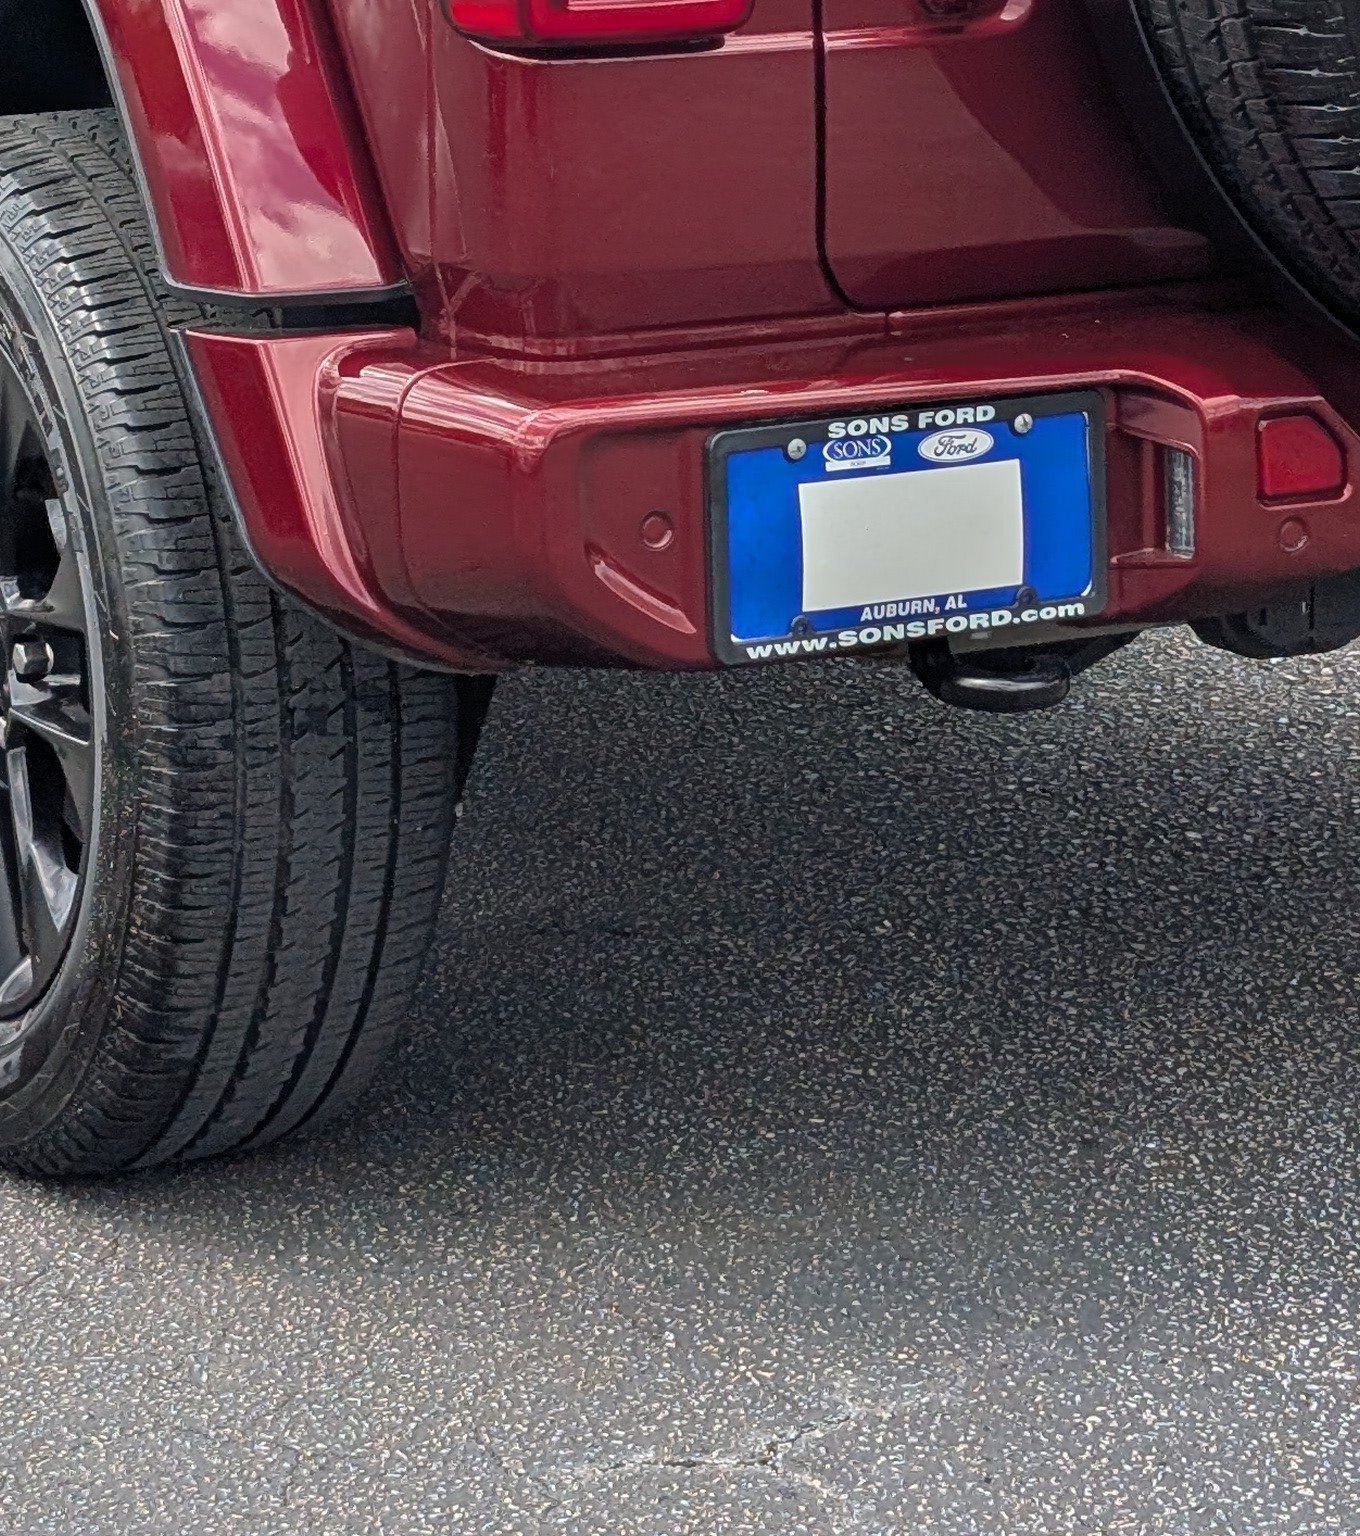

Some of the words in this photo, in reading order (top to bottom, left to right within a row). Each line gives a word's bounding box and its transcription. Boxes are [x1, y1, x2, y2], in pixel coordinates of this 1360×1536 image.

[828, 413, 908, 438] SONS
[919, 405, 996, 430] FORD
[831, 436, 882, 460] SONS
[933, 435, 978, 458] Ford
[860, 599, 940, 622] AUBURN,
[944, 595, 968, 611] AL
[746, 602, 1085, 660] www.SONSFORD.com
